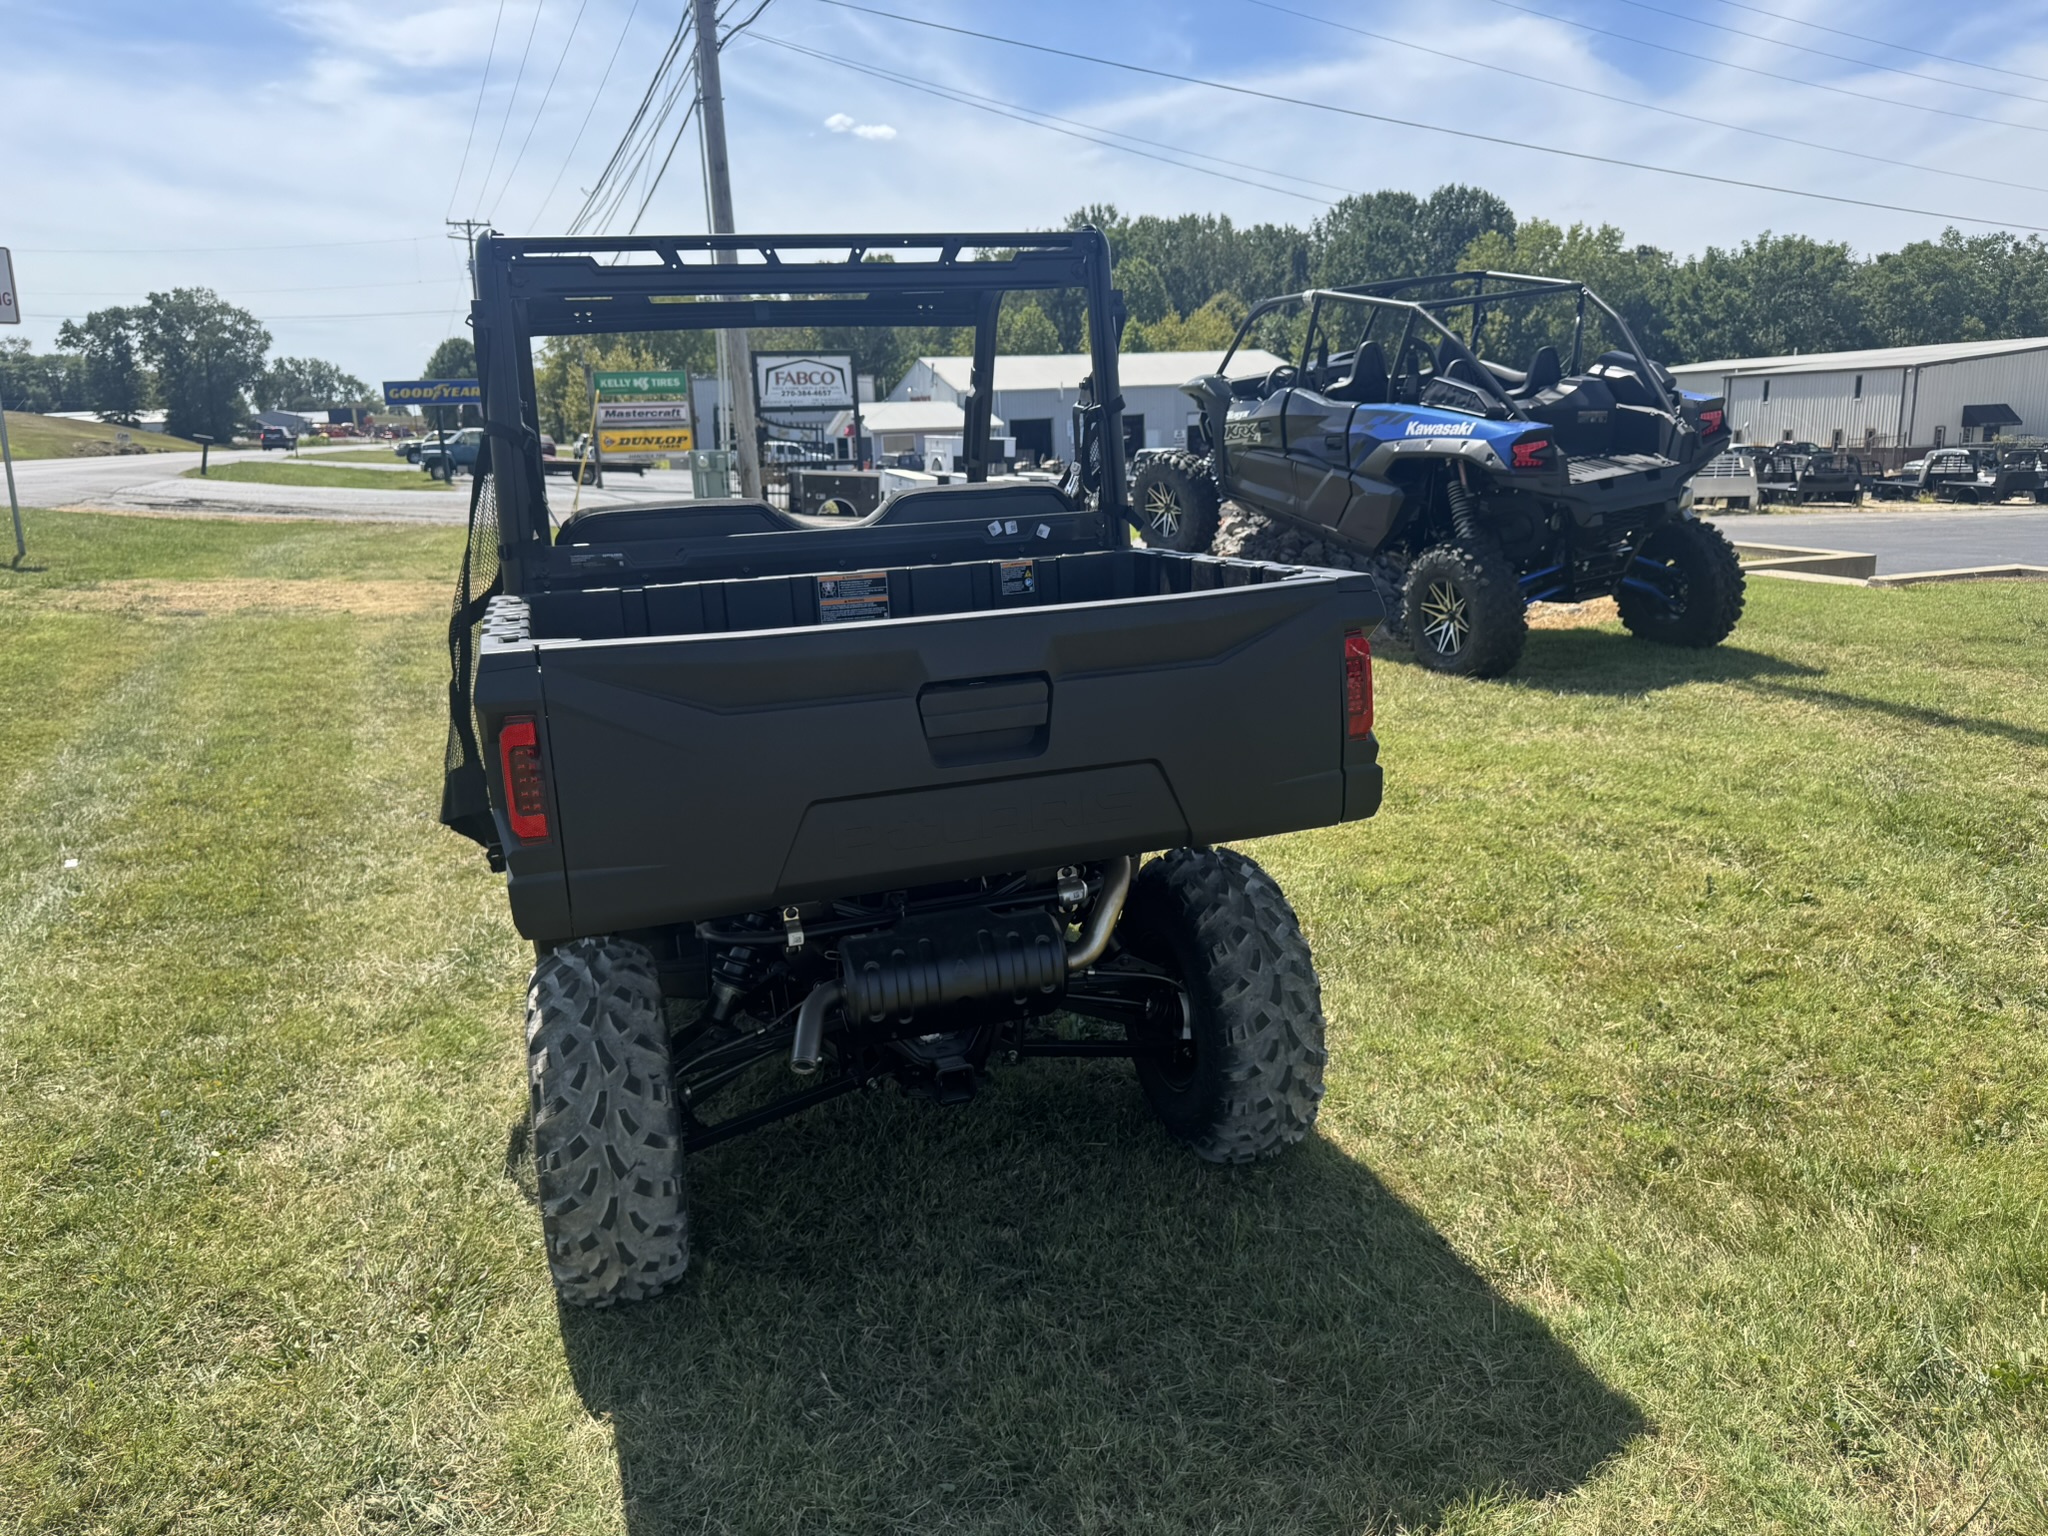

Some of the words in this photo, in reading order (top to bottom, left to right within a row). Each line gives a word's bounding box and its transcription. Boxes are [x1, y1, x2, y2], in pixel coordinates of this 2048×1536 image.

[600, 378, 631, 388] KELLY
[652, 377, 681, 387] TIRES
[775, 371, 835, 386] FABCO
[389, 383, 480, 401] GOODYEAR
[604, 408, 681, 418] Mastercraft
[1224, 422, 1258, 440] KRX
[1405, 421, 1477, 436] Kawasaki
[618, 435, 689, 447] DUNLOP
[831, 786, 1138, 860] POLARIS
